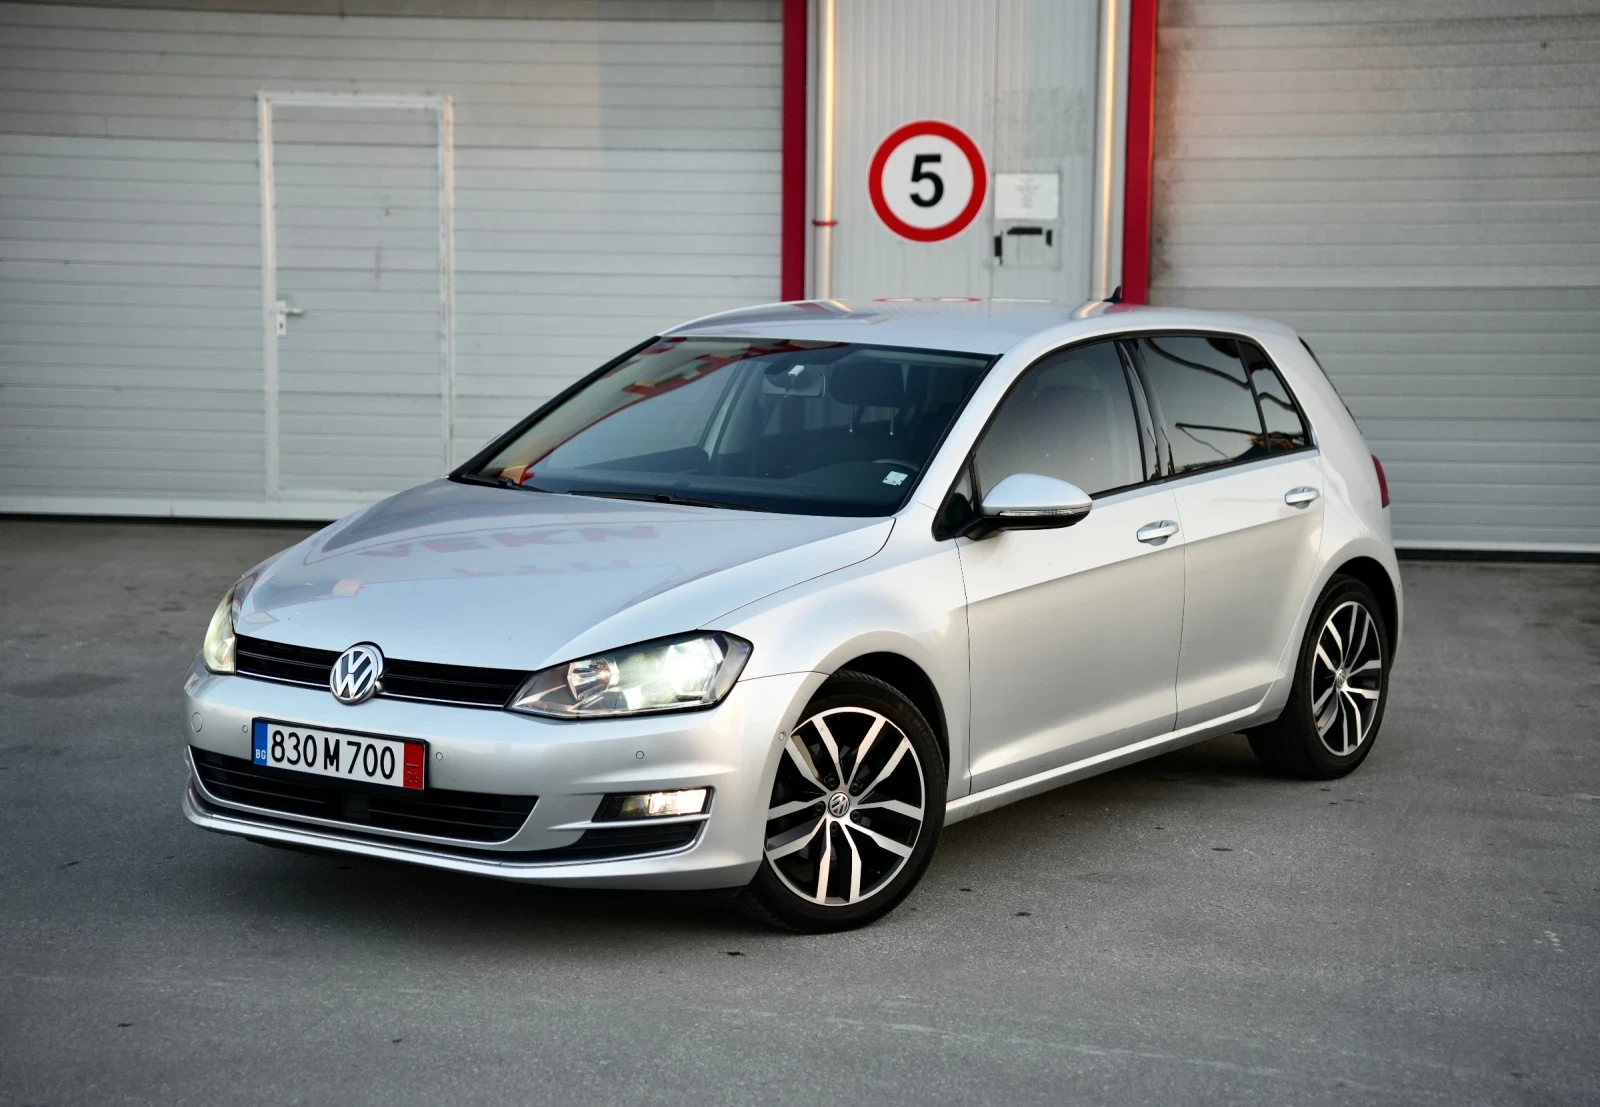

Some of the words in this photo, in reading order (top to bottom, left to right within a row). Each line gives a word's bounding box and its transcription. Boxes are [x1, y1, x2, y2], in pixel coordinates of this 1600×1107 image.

[909, 153, 944, 208] 5
[331, 645, 379, 701] VW
[255, 748, 267, 760] BG
[271, 730, 317, 767] 830
[323, 737, 340, 772] M
[346, 740, 395, 780] 700
